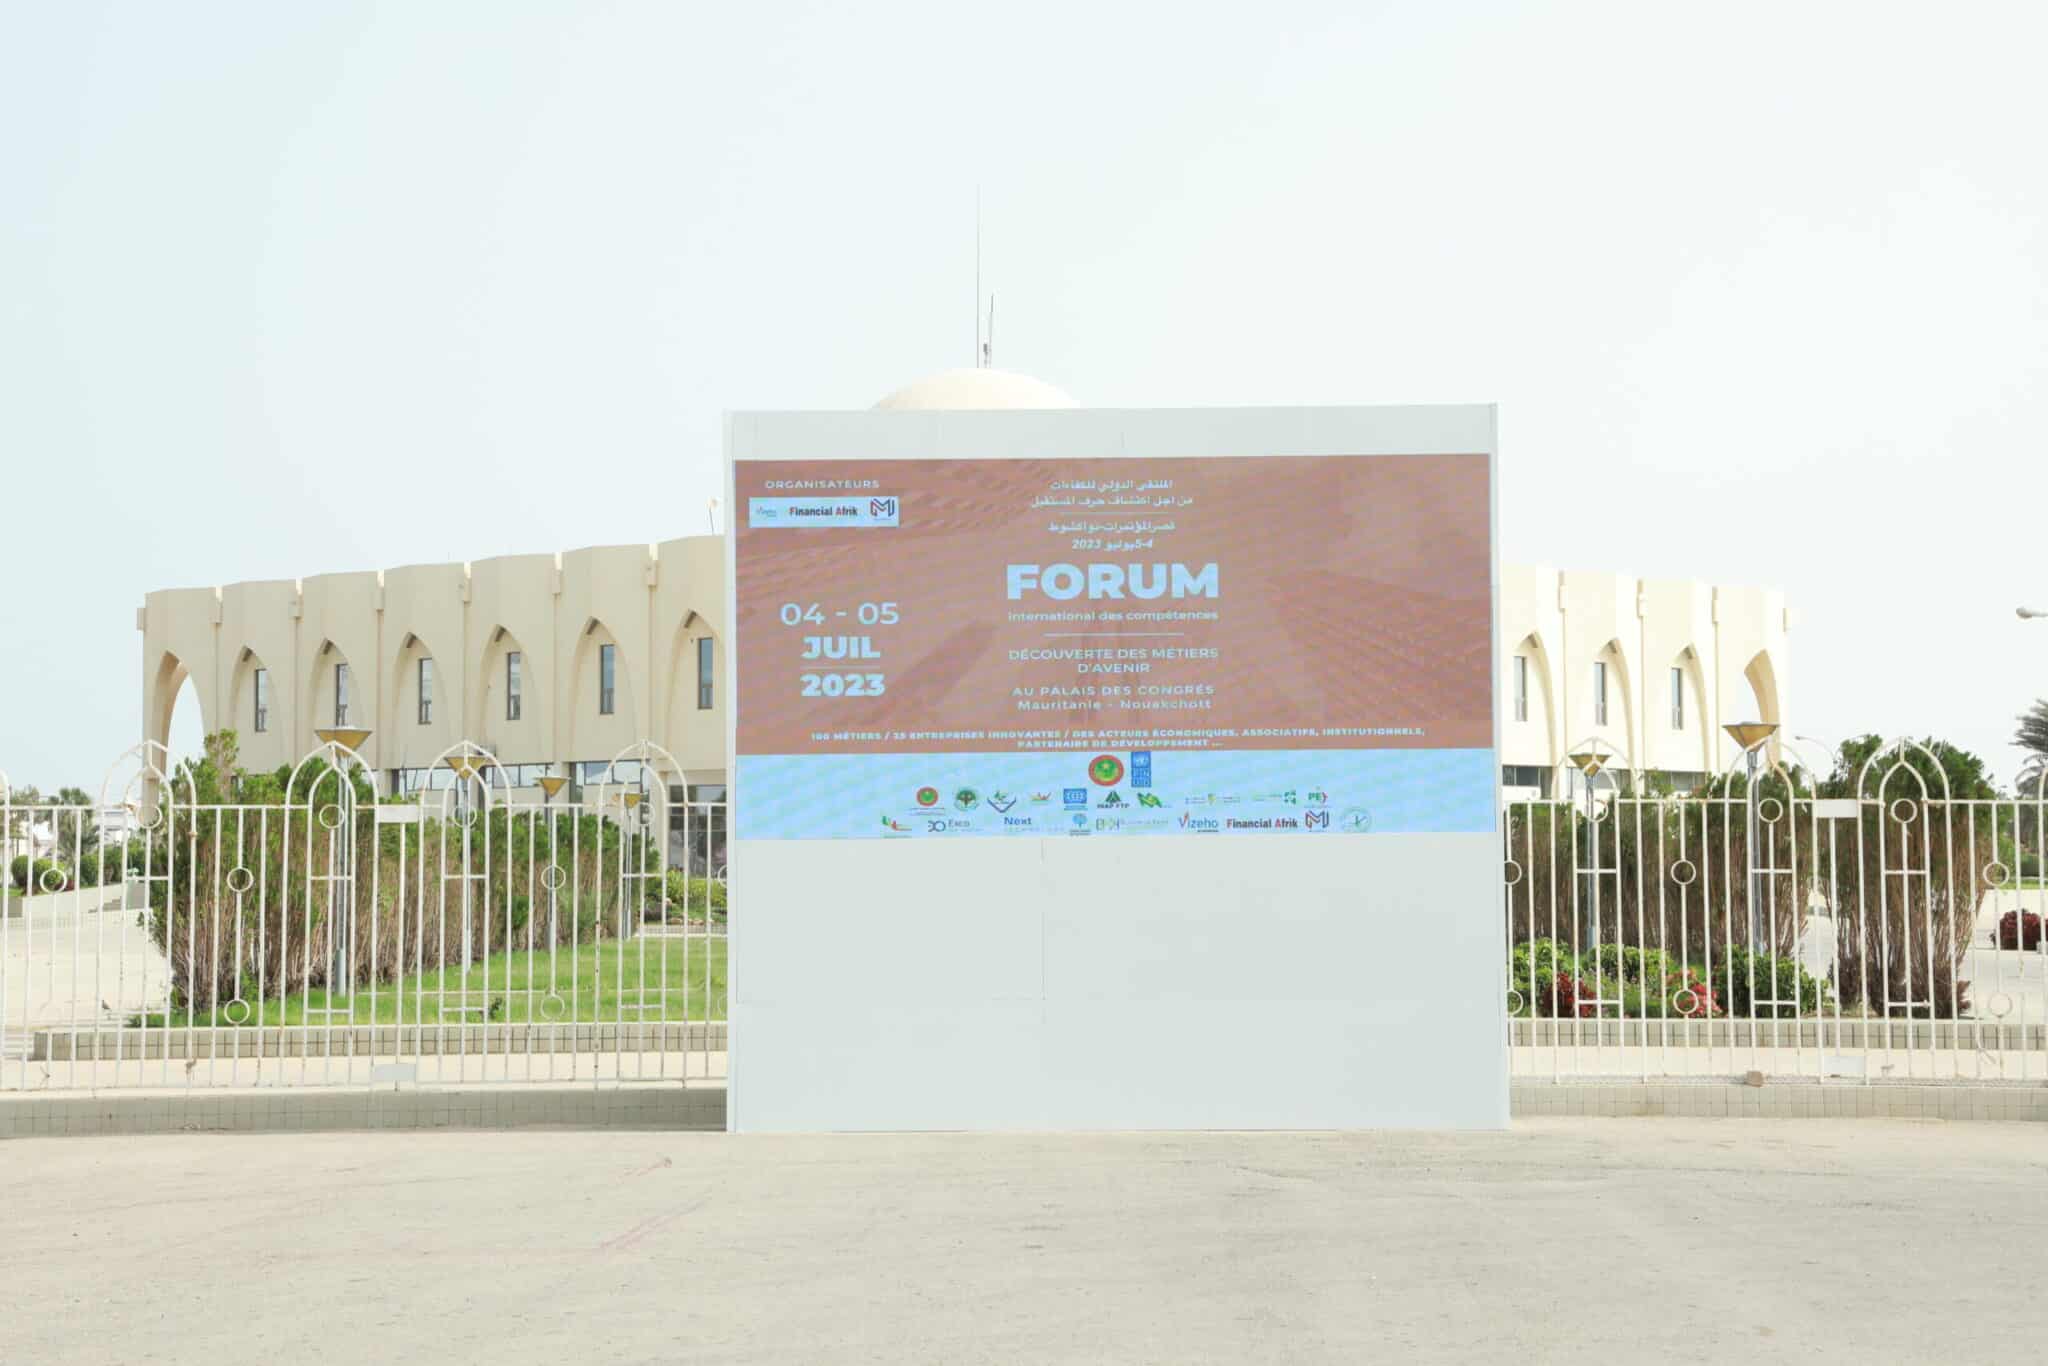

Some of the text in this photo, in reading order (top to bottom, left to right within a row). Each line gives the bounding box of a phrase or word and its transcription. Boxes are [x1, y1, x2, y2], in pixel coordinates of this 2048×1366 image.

[765, 479, 880, 489] ORGANISATEURS
[789, 506, 833, 517] Financial
[835, 506, 858, 517] Afrik
[1006, 562, 1219, 600] FORUM
[781, 602, 826, 625] 04
[858, 602, 899, 625] 05
[1008, 610, 1095, 622] international
[1098, 611, 1123, 621] des
[801, 636, 880, 659] JUIL
[1008, 647, 1113, 660] DÉCOUVERTE
[1118, 648, 1148, 659] DES
[1078, 663, 1151, 673] D'AVENIR
[801, 674, 886, 697] 2023
[1011, 687, 1035, 697] AU
[1040, 686, 1096, 697] PALAIS
[1102, 685, 1131, 696] DES
[1017, 700, 1101, 711] Mauritanie
[1120, 699, 1212, 710] Nouakchott
[1072, 729, 1095, 739] DES
[1098, 729, 1149, 739] ACTEURS
[1004, 816, 1032, 826] Next
[1226, 818, 1298, 828] Financial Afrik
